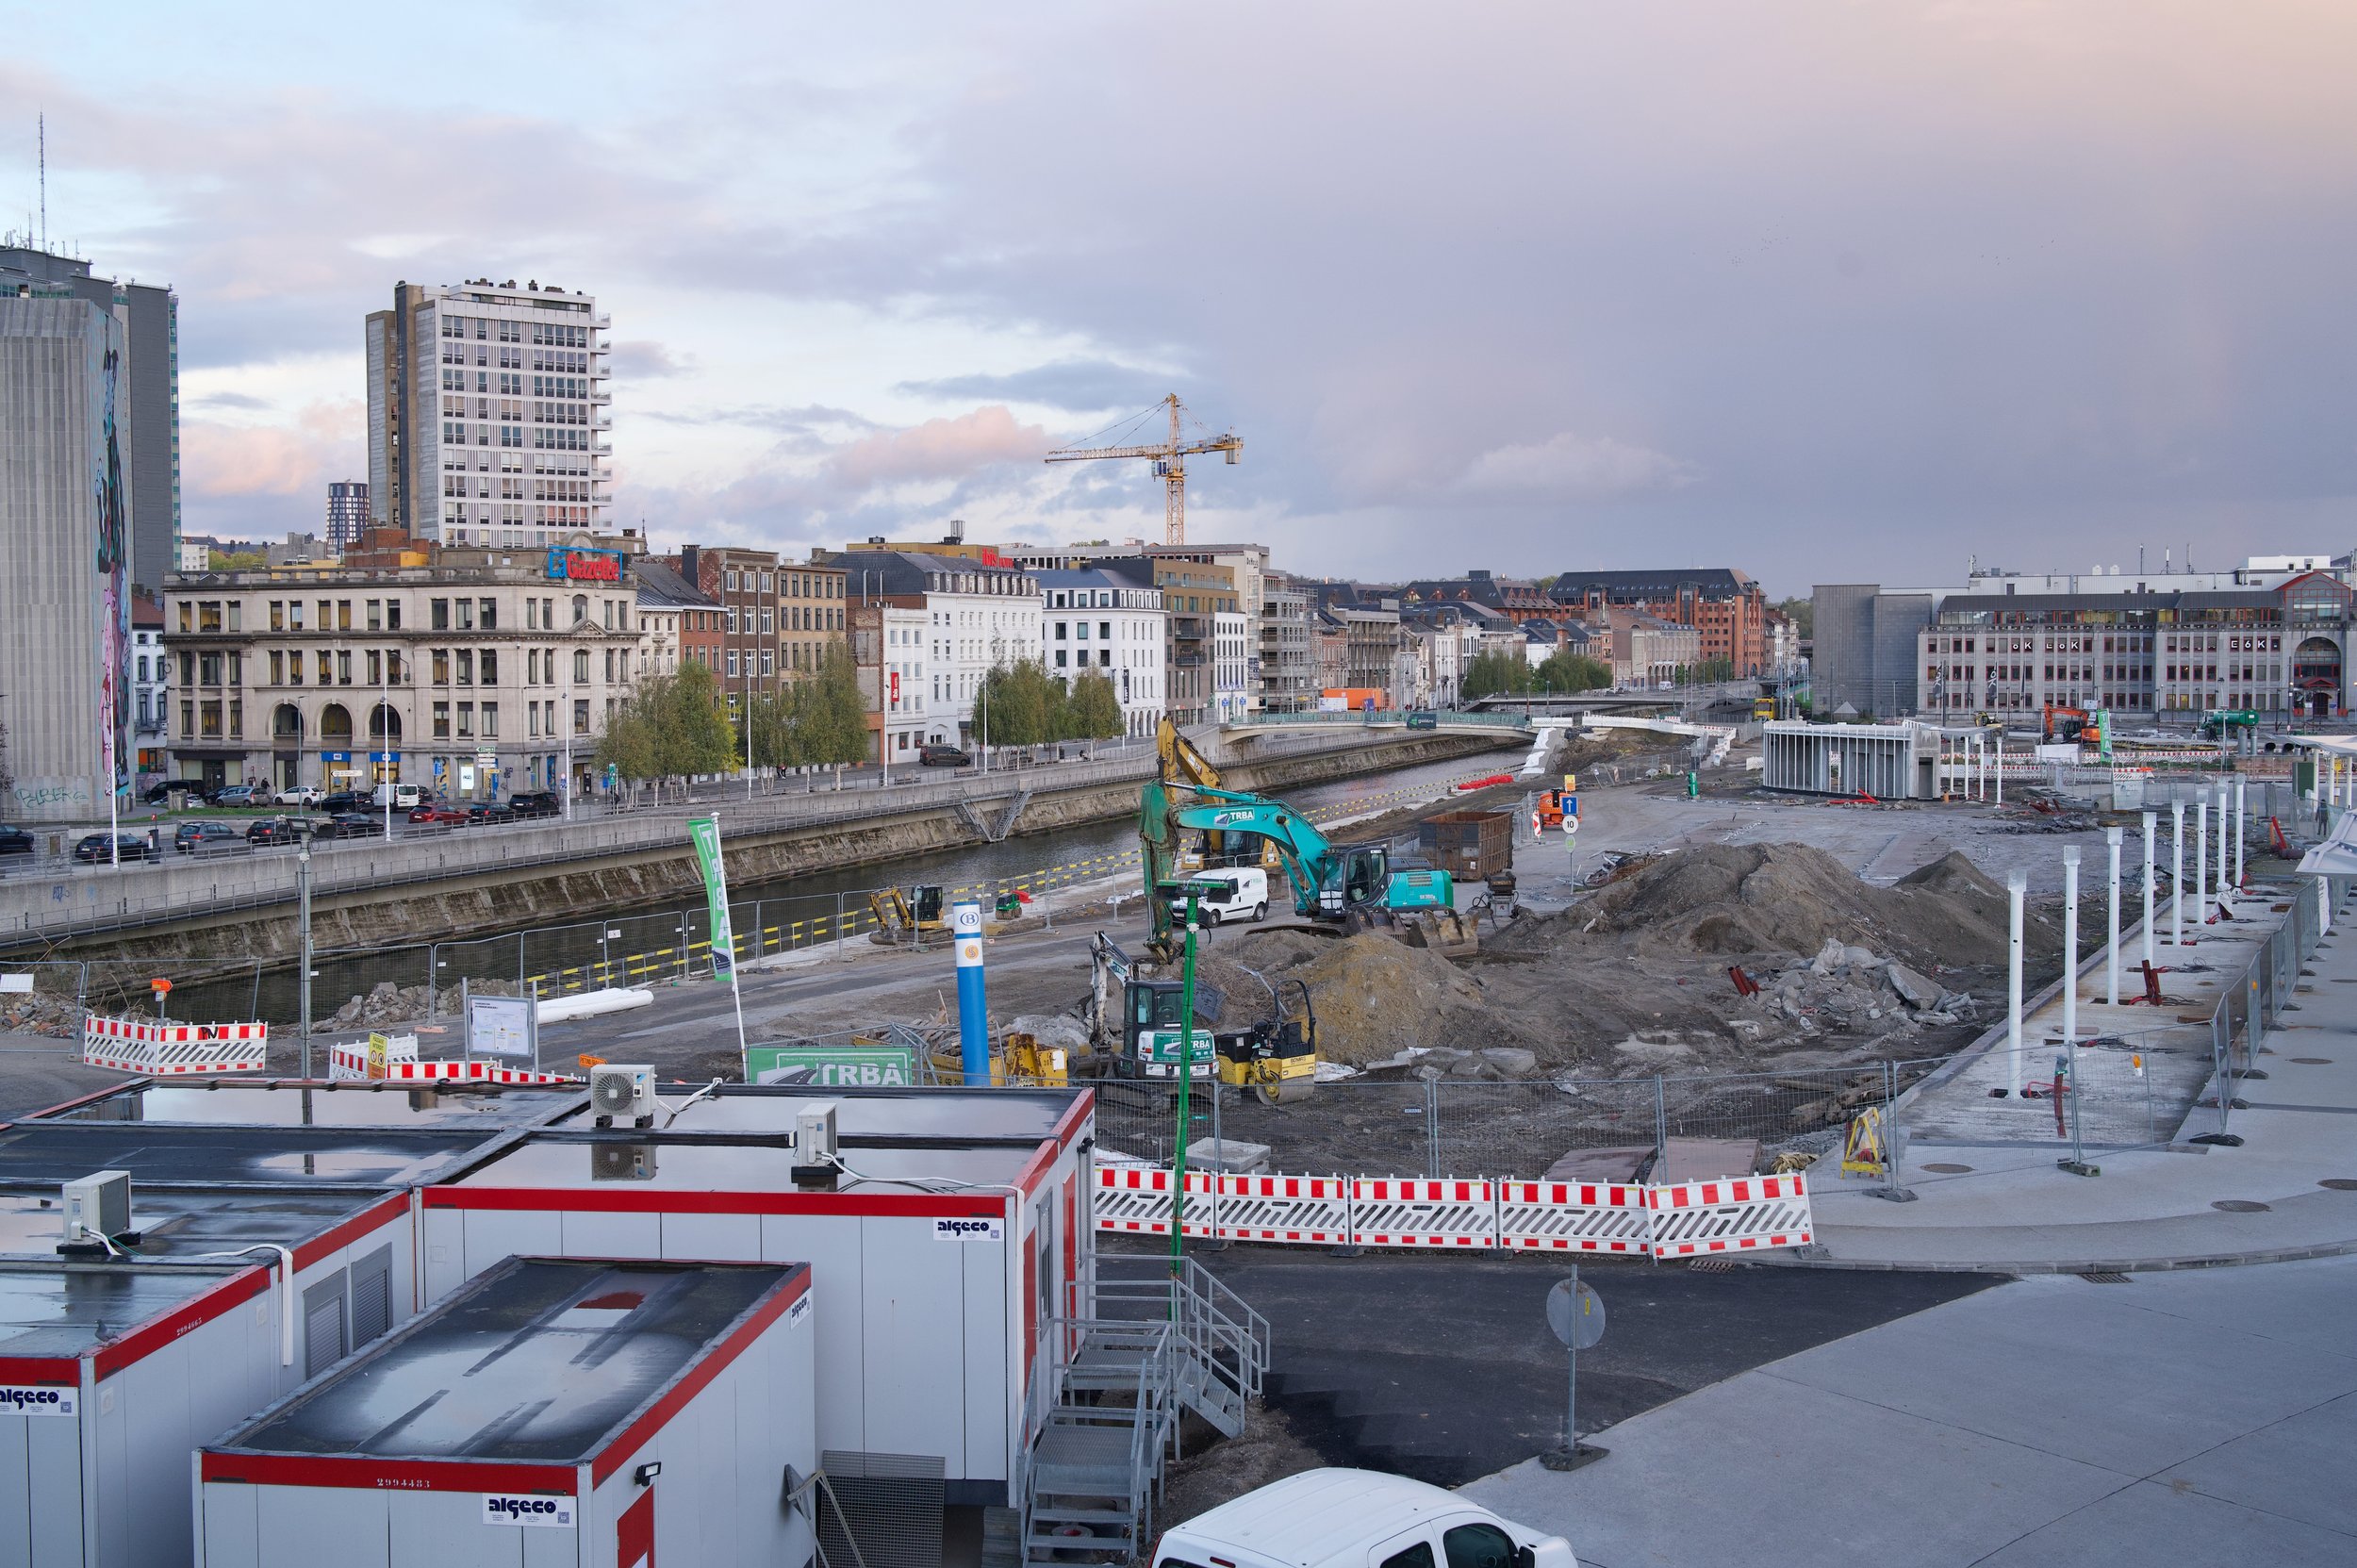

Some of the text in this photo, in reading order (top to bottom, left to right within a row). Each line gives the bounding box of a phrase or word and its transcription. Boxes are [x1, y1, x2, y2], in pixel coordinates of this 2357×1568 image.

[548, 552, 619, 581] La Gazette
[2101, 713, 2111, 749] TRBA
[1229, 810, 1254, 820] TRBA
[1566, 820, 1574, 829] 10
[701, 830, 728, 941] TRBA
[1191, 1039, 1211, 1050] RBA
[816, 1063, 904, 1084] TRBA
[938, 1220, 990, 1237] algeco
[792, 1296, 807, 1318] algeco
[377, 1477, 431, 1489] 2994483
[488, 1497, 556, 1520] algeco
